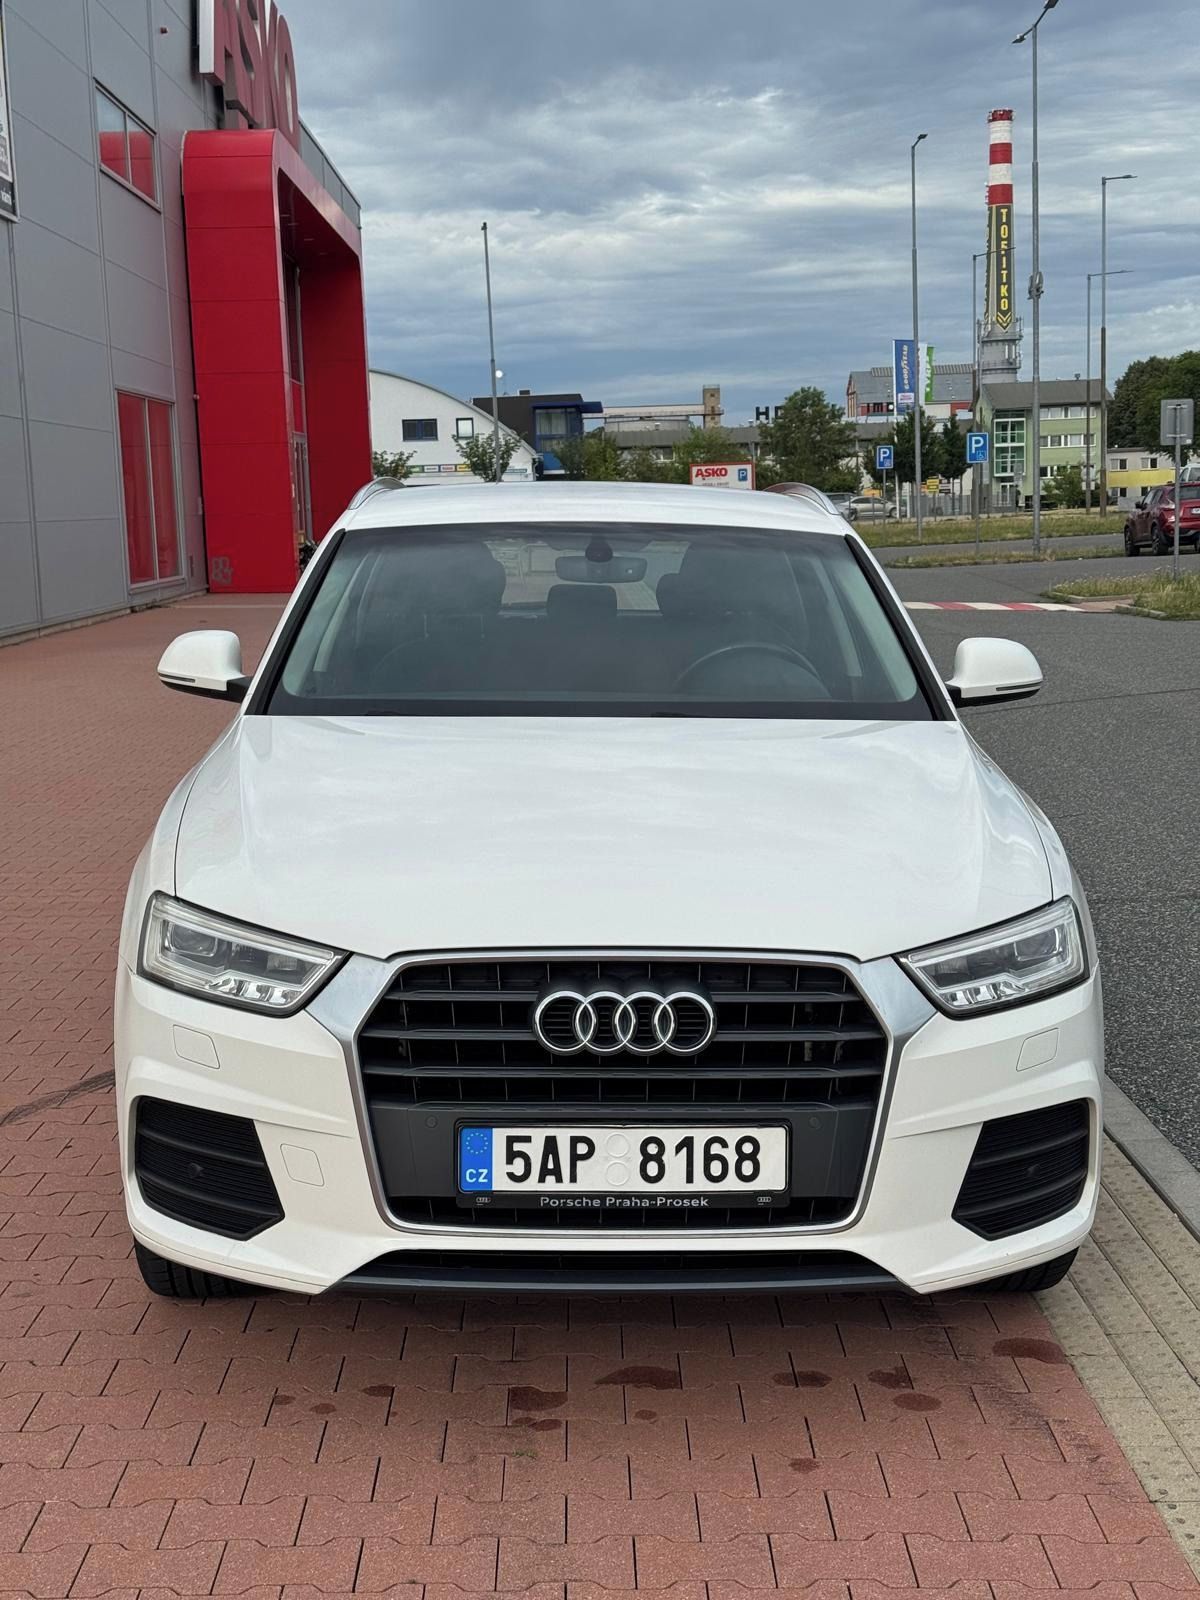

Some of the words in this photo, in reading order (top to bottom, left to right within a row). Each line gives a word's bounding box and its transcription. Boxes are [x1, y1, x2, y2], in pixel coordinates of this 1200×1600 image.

[972, 436, 984, 454] P
[880, 448, 890, 462] P
[695, 467, 728, 478] ASKO
[505, 1135, 596, 1184] 5AP
[639, 1135, 761, 1184] 8168
[465, 1168, 488, 1183] CZ
[540, 1196, 601, 1207] Porsche
[605, 1196, 709, 1207] Praha-Prosek
